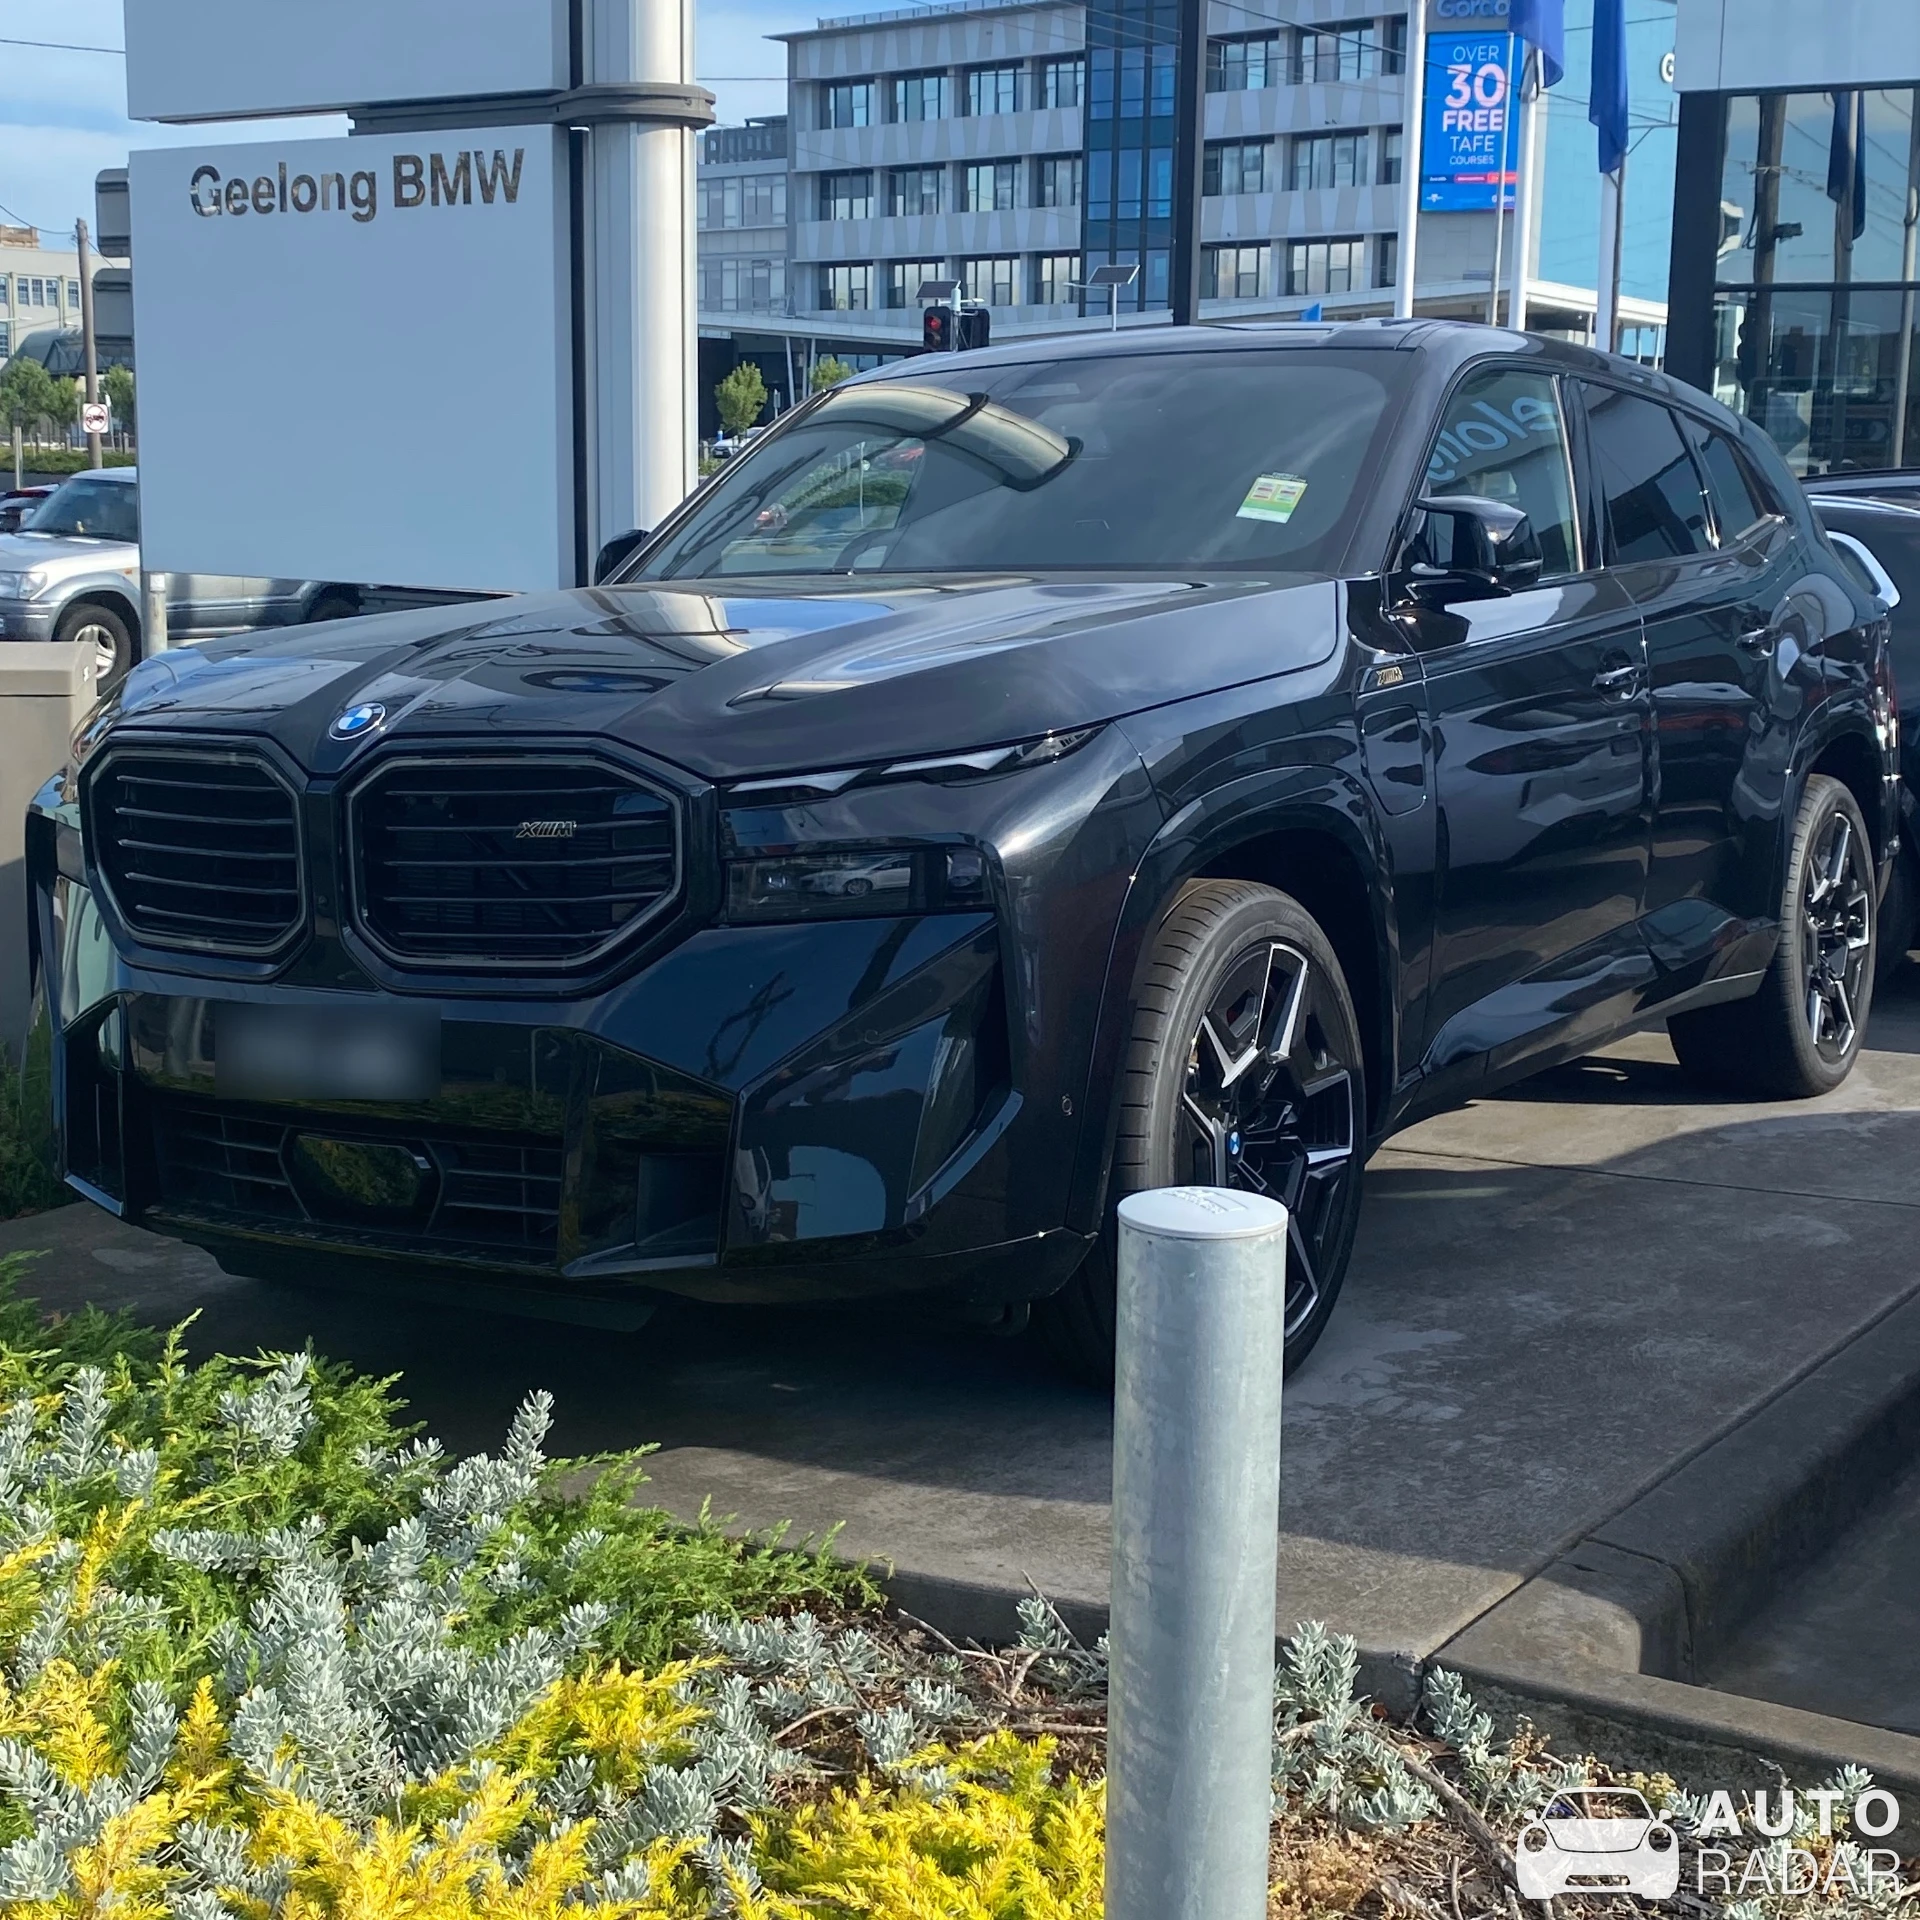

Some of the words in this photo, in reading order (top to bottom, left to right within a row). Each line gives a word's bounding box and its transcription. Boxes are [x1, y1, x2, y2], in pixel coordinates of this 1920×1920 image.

[1453, 45, 1500, 62] OVER
[1444, 63, 1506, 108] 30
[1442, 109, 1503, 132] FREE
[1449, 135, 1495, 152] TAFE
[1449, 155, 1495, 165] COURSES
[189, 161, 377, 223] Geelong
[393, 148, 525, 208] BMW
